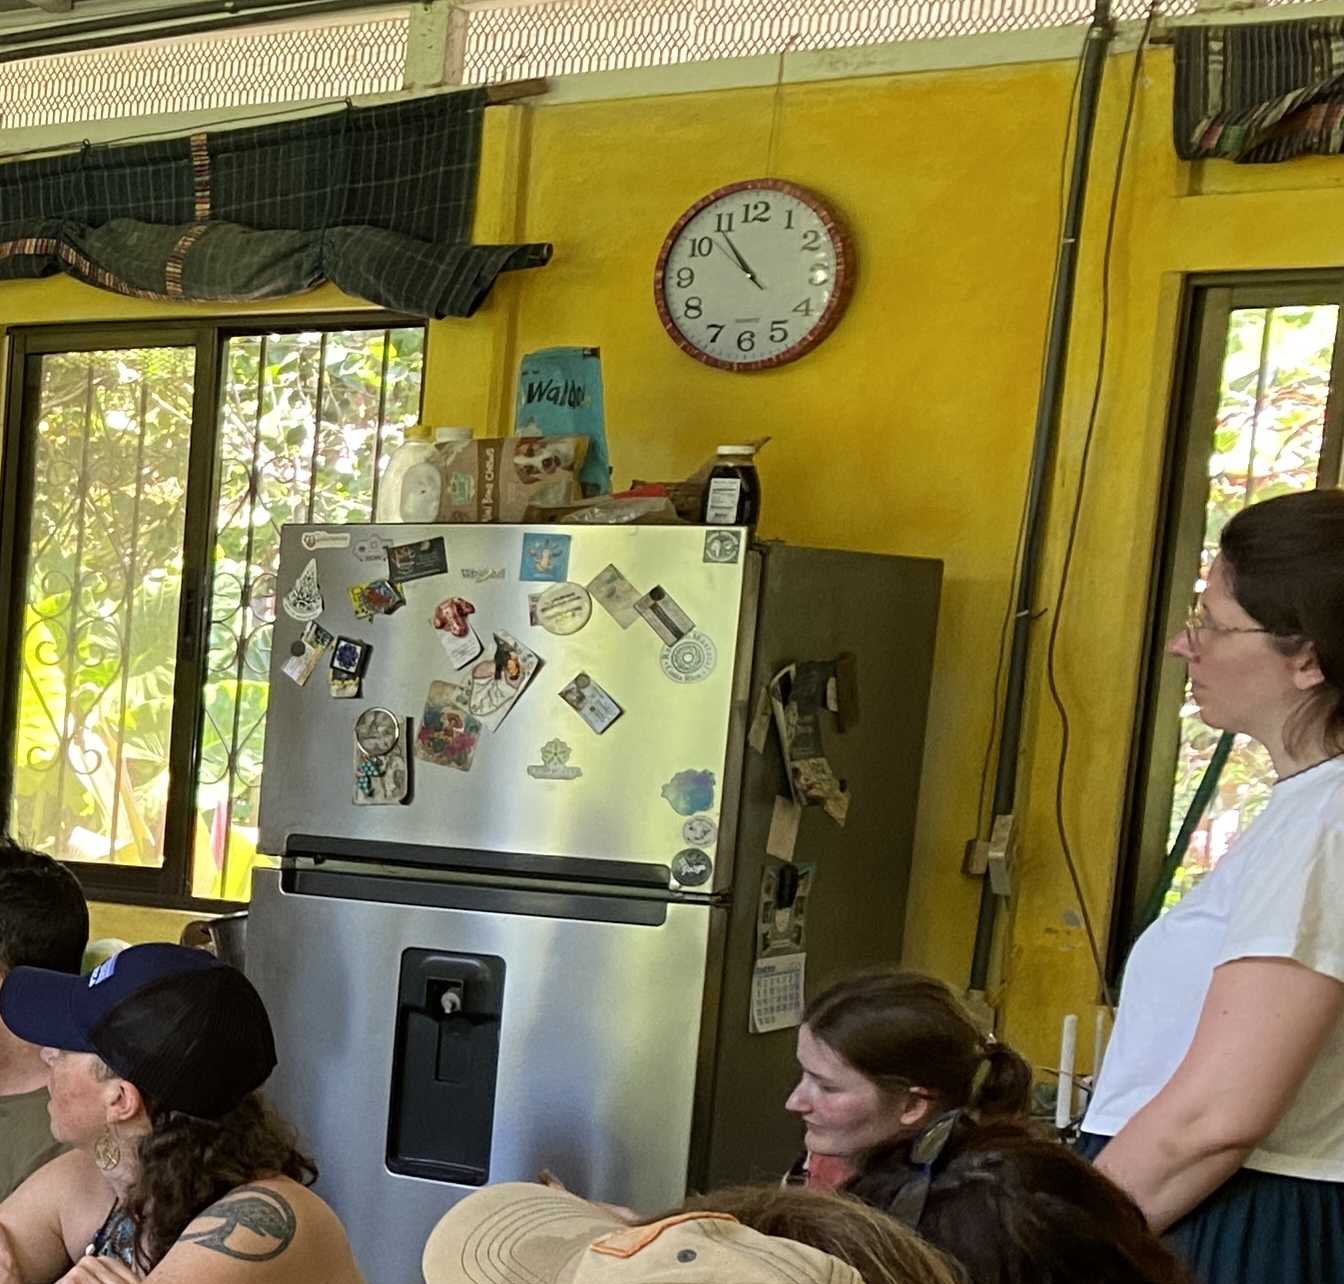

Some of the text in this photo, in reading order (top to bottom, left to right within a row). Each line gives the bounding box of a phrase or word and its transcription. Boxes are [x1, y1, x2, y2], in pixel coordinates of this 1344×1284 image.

[715, 213, 734, 232] 11
[741, 201, 771, 223] 12
[785, 210, 795, 229] 1
[689, 236, 713, 257] 10
[801, 230, 821, 252] 2
[677, 267, 695, 288] 9
[684, 297, 703, 319] 8
[792, 298, 814, 317] 4
[707, 324, 725, 343] 7
[737, 331, 756, 352] 6
[770, 320, 789, 343] 5
